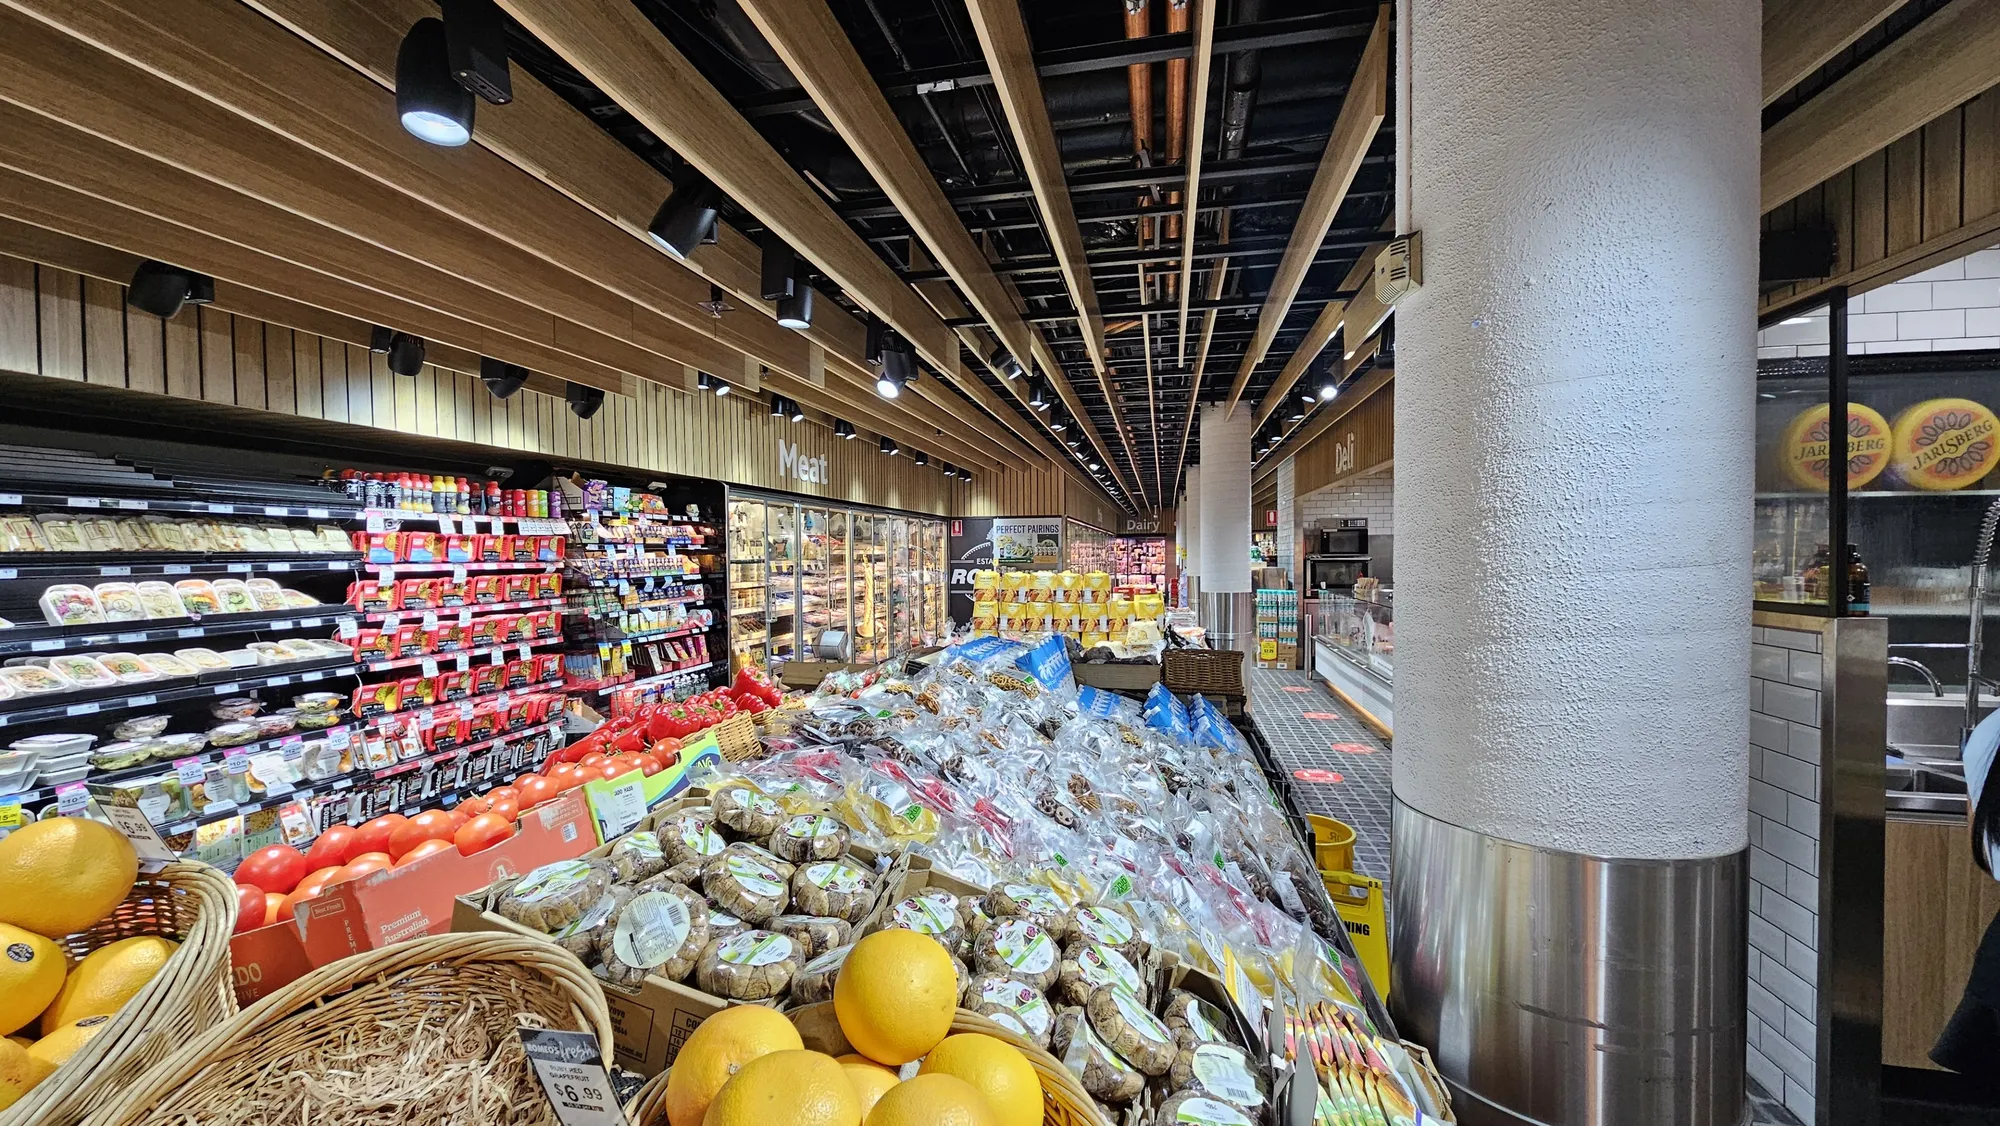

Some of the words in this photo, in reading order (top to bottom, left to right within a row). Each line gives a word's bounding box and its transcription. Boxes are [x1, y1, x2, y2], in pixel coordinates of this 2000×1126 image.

[1335, 432, 1355, 474] Deli
[1794, 438, 1885, 460] JARBERG
[1913, 420, 1994, 470] JARLSBERG
[779, 438, 828, 484] Meat
[996, 524, 1026, 534] PERFECT
[1027, 524, 1059, 534] PAIRINGS
[1127, 519, 1160, 532] Dairy
[380, 910, 421, 932] Premium
[384, 917, 429, 944] Australian
[1345, 922, 1370, 936] NING
[343, 919, 359, 954] PREMI
[526, 1043, 560, 1055] ROMEO'S
[559, 1040, 594, 1062] fresh
[550, 1072, 589, 1082] GRAPEFRUIT
[554, 1083, 602, 1102] $6.99
